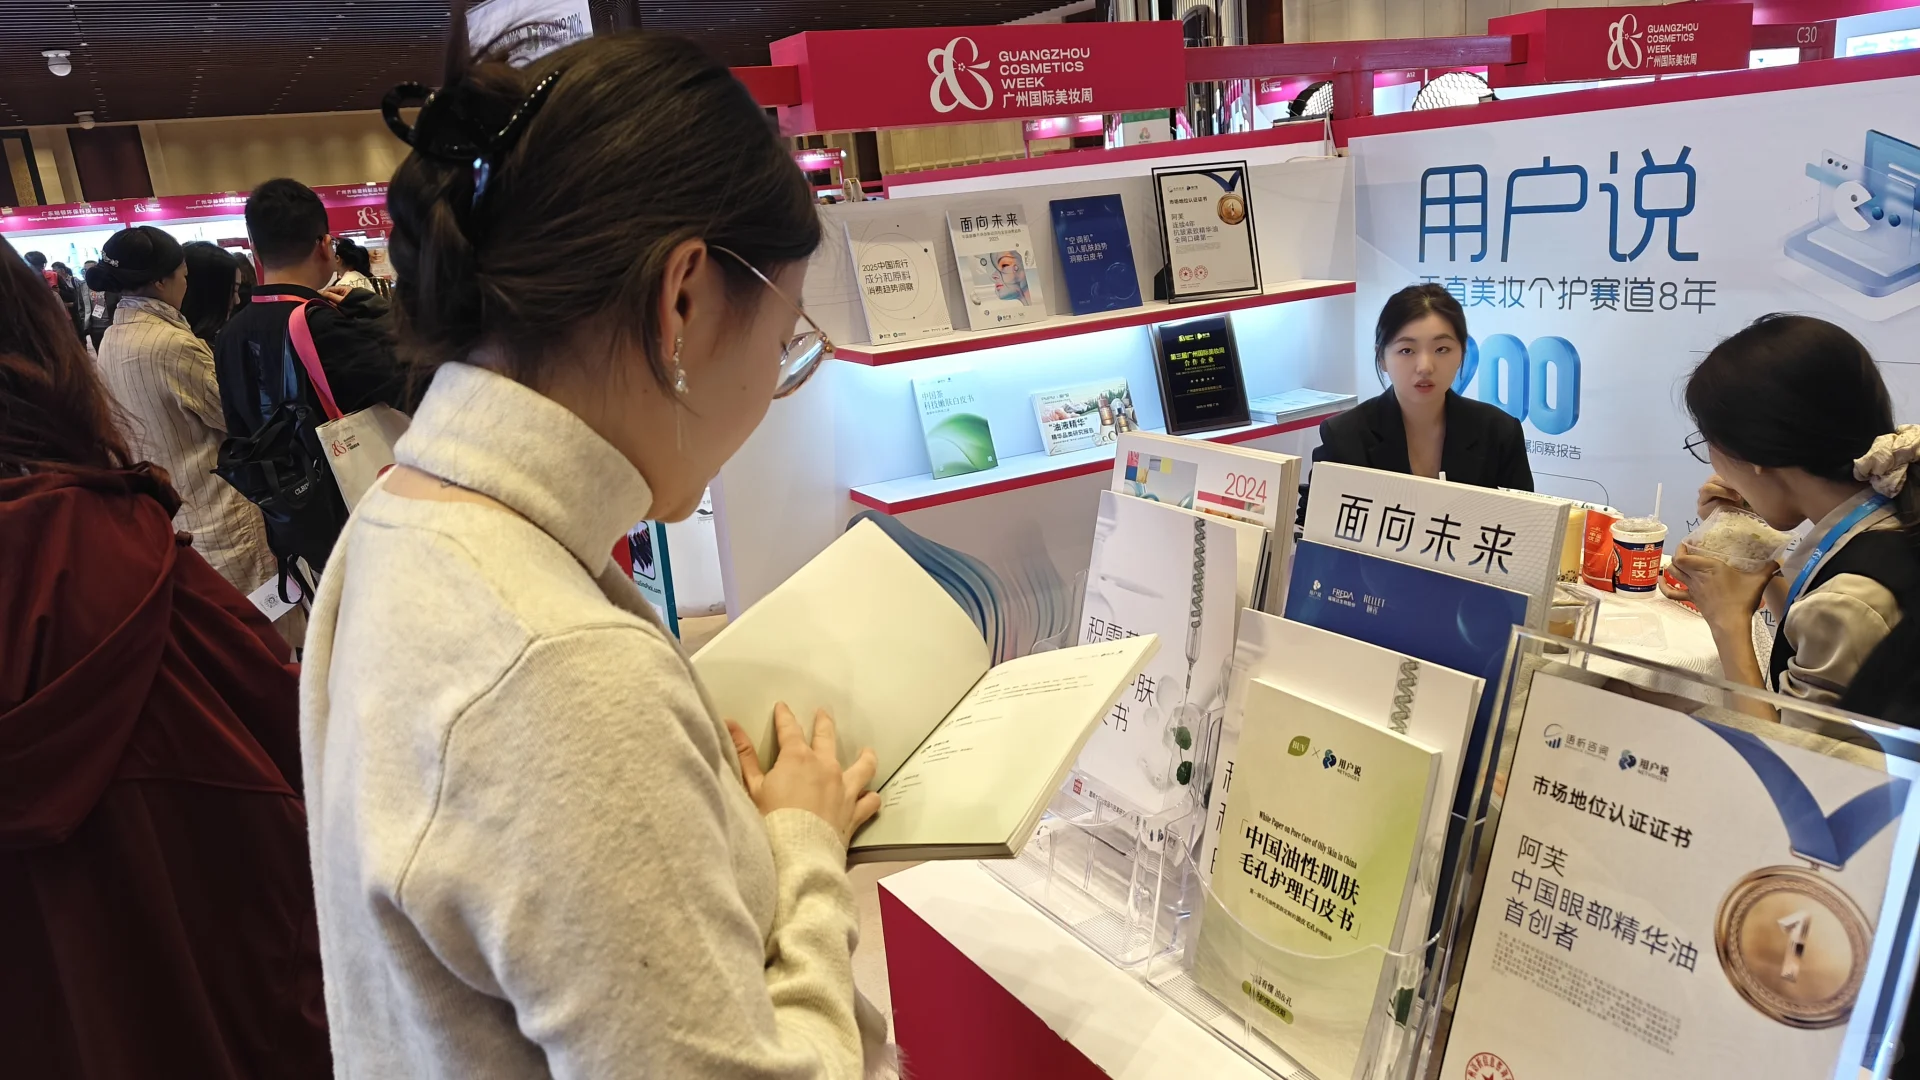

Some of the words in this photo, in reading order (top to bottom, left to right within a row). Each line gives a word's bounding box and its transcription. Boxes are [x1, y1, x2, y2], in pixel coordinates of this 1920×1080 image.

[1647, 22, 1699, 33] GUANGZHOU
[1796, 26, 1817, 44] C30
[1647, 33, 1694, 43] COSMETICS
[998, 47, 1090, 63] GUANGZHOU
[1646, 44, 1671, 54] WEEK
[999, 61, 1084, 76] COSMETICS
[1645, 54, 1698, 68] 广州国际美妆周
[1001, 76, 1044, 89] WEEK
[1002, 88, 1093, 109] 广州国际美妆周
[1418, 145, 1699, 263] 用户说
[960, 212, 1019, 233] 面向未来
[862, 259, 909, 272] 2025中国流行
[1069, 252, 1104, 263] 洞察白皮书
[864, 270, 911, 285] 成分和原料
[866, 282, 914, 296] 消费趋势洞察
[1225, 472, 1268, 504] 2024
[1334, 493, 1516, 575] 面向未来
[1332, 587, 1355, 600] FREDA
[1102, 702, 1130, 733] 书
[1291, 740, 1307, 753] BUV
[1338, 758, 1362, 777] 用户说
[1639, 758, 1669, 777] 用户说
[1532, 775, 1693, 849] 市场地位认证证书
[1259, 810, 1271, 824] White
[1272, 817, 1285, 830] Paper
[1284, 825, 1291, 834] on
[1290, 827, 1302, 840] Pore
[1301, 833, 1312, 845] Care
[1311, 839, 1318, 848] of
[1317, 841, 1327, 854] Oily
[1327, 846, 1338, 859] Skin
[1337, 851, 1343, 862] in
[1343, 855, 1358, 870] China
[1517, 834, 1568, 878] 阿芙
[1504, 896, 1579, 952] 首创者
[1511, 868, 1699, 974] 中国眼部精华油
